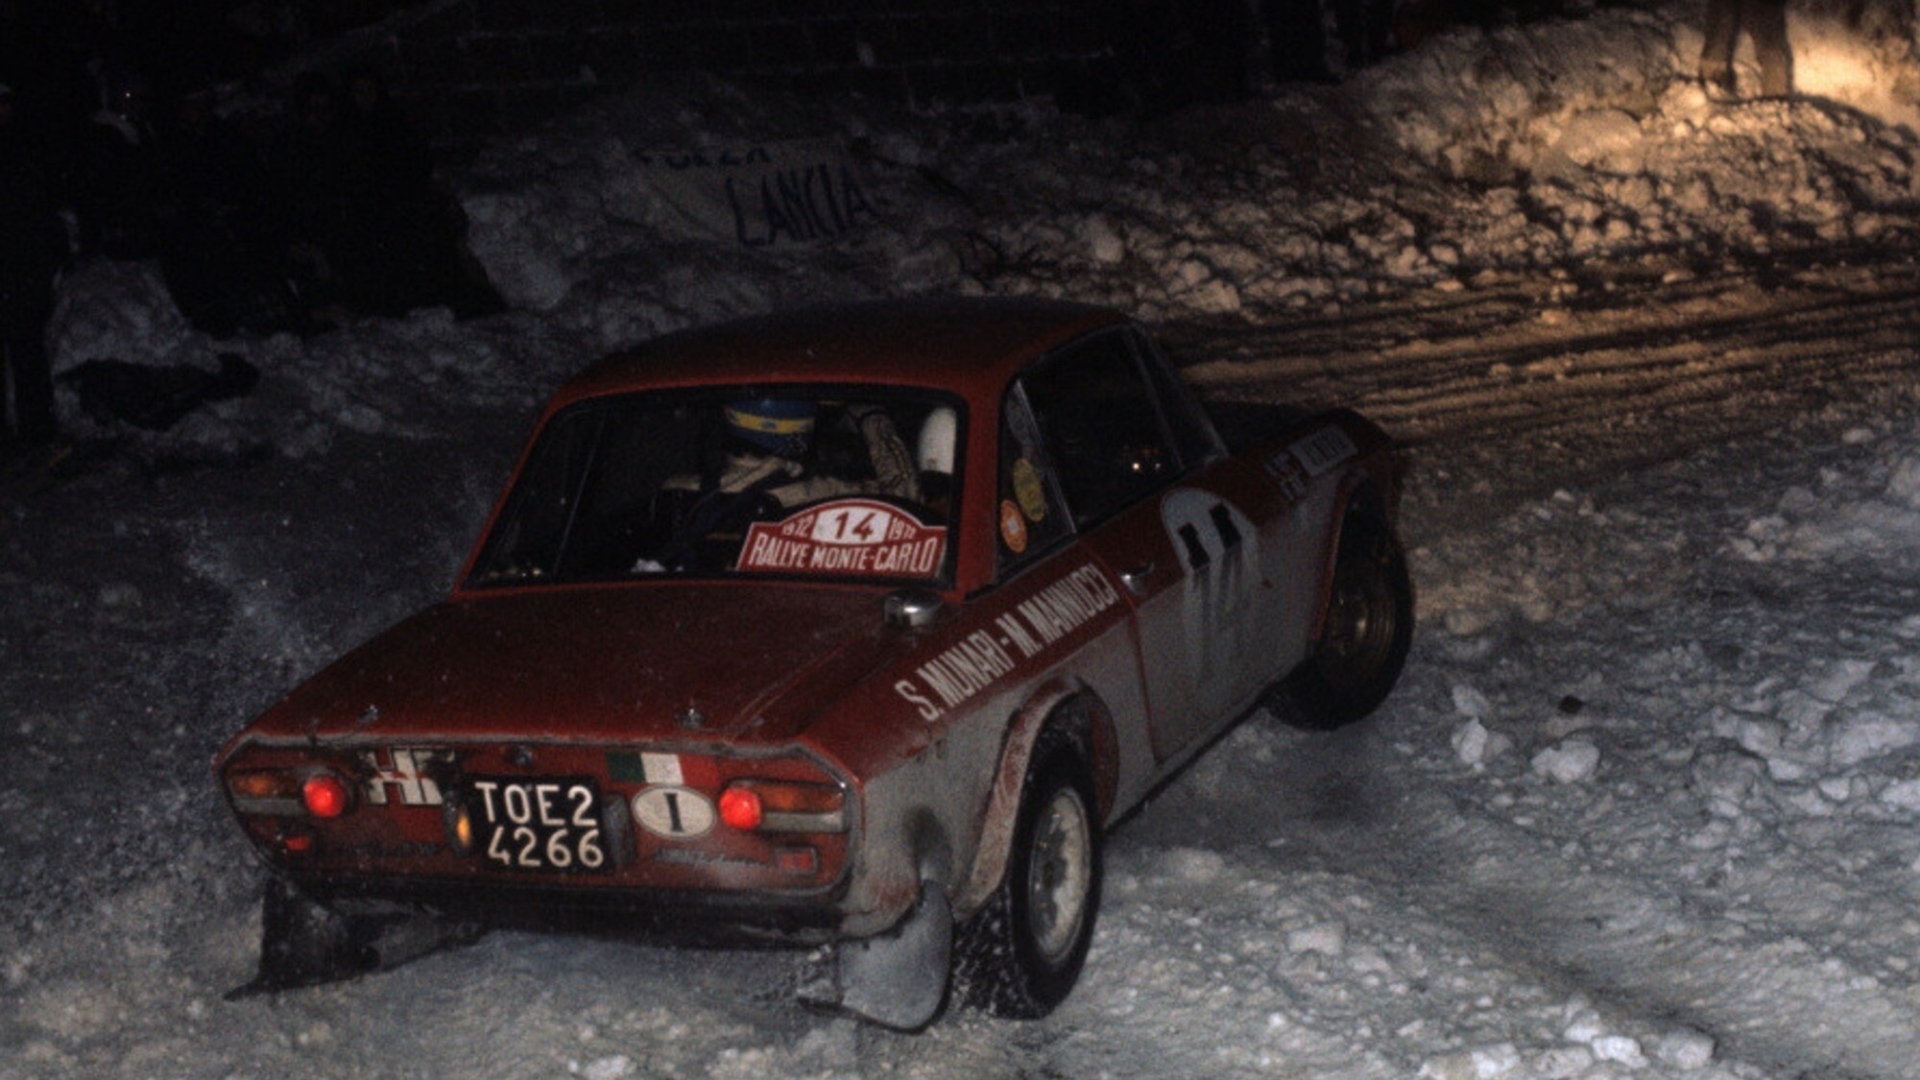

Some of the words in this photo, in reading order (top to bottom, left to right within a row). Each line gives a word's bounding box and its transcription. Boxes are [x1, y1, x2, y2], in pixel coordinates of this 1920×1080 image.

[726, 163, 882, 246] LANCIA
[834, 511, 876, 541] 14
[748, 532, 809, 568] RALLYE
[811, 536, 938, 573] MONTE-CARLO
[894, 679, 945, 722] S.
[1017, 562, 1121, 645] MANNUCCI
[663, 793, 684, 832] I
[486, 825, 604, 869] 4266
